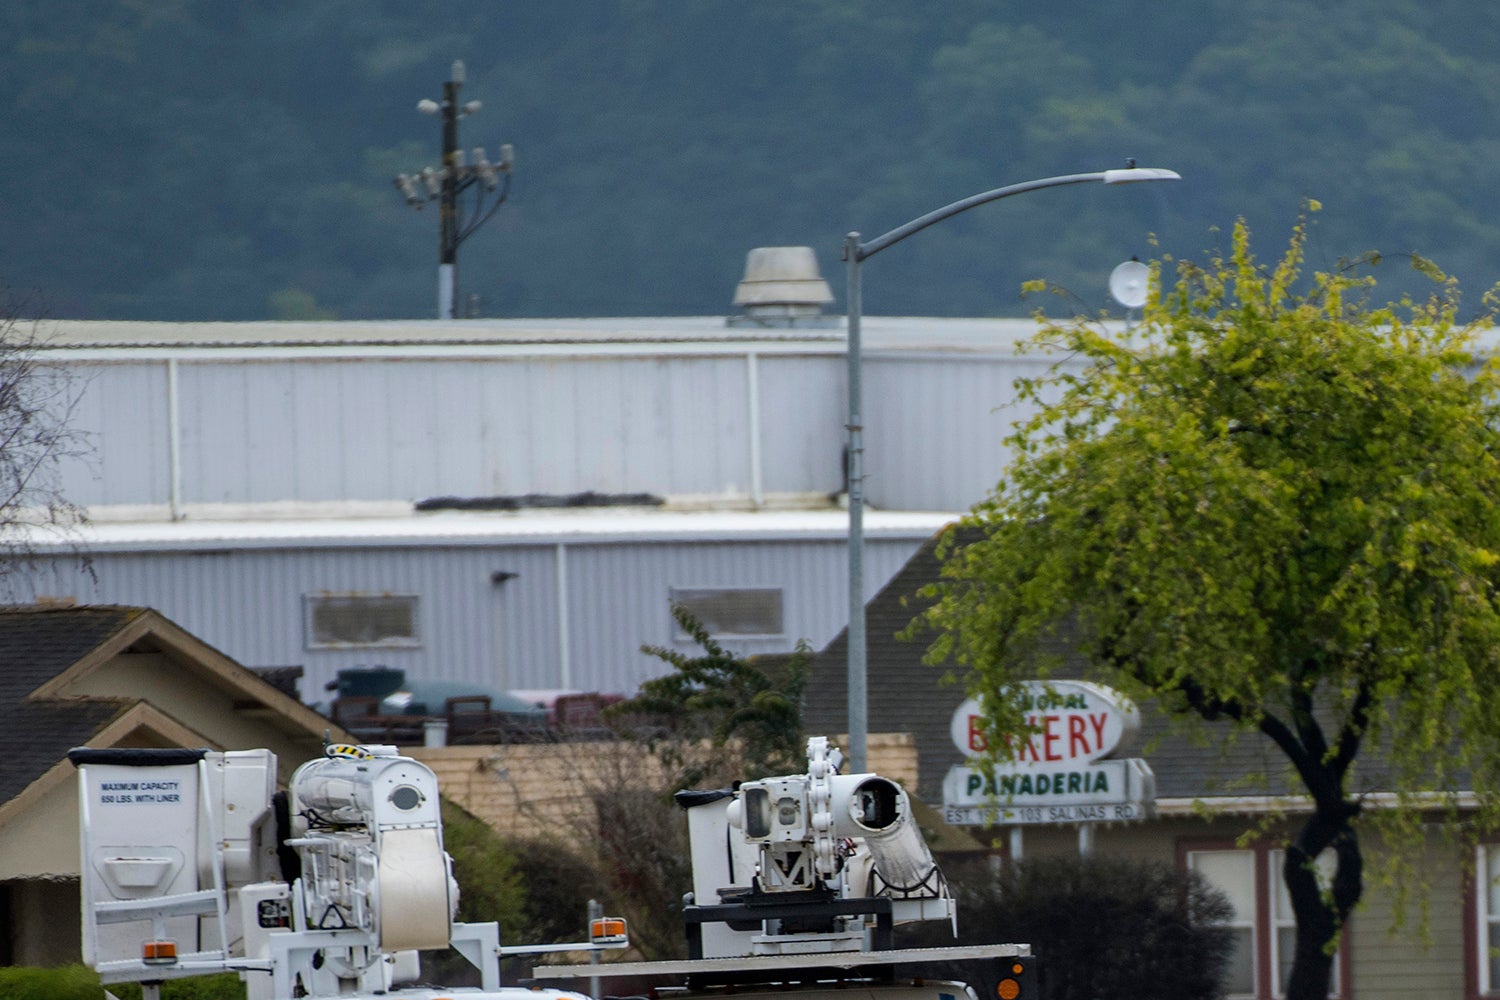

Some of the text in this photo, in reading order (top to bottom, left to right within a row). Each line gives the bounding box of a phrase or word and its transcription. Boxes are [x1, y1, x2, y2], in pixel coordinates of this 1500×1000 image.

[967, 713, 1108, 762] BKERY
[140, 782, 178, 790] CAPACITY
[967, 771, 1109, 796] PANADERIA
[157, 794, 179, 802] LINER
[1020, 807, 1041, 821] 103
[1050, 804, 1105, 819] SALINAS
